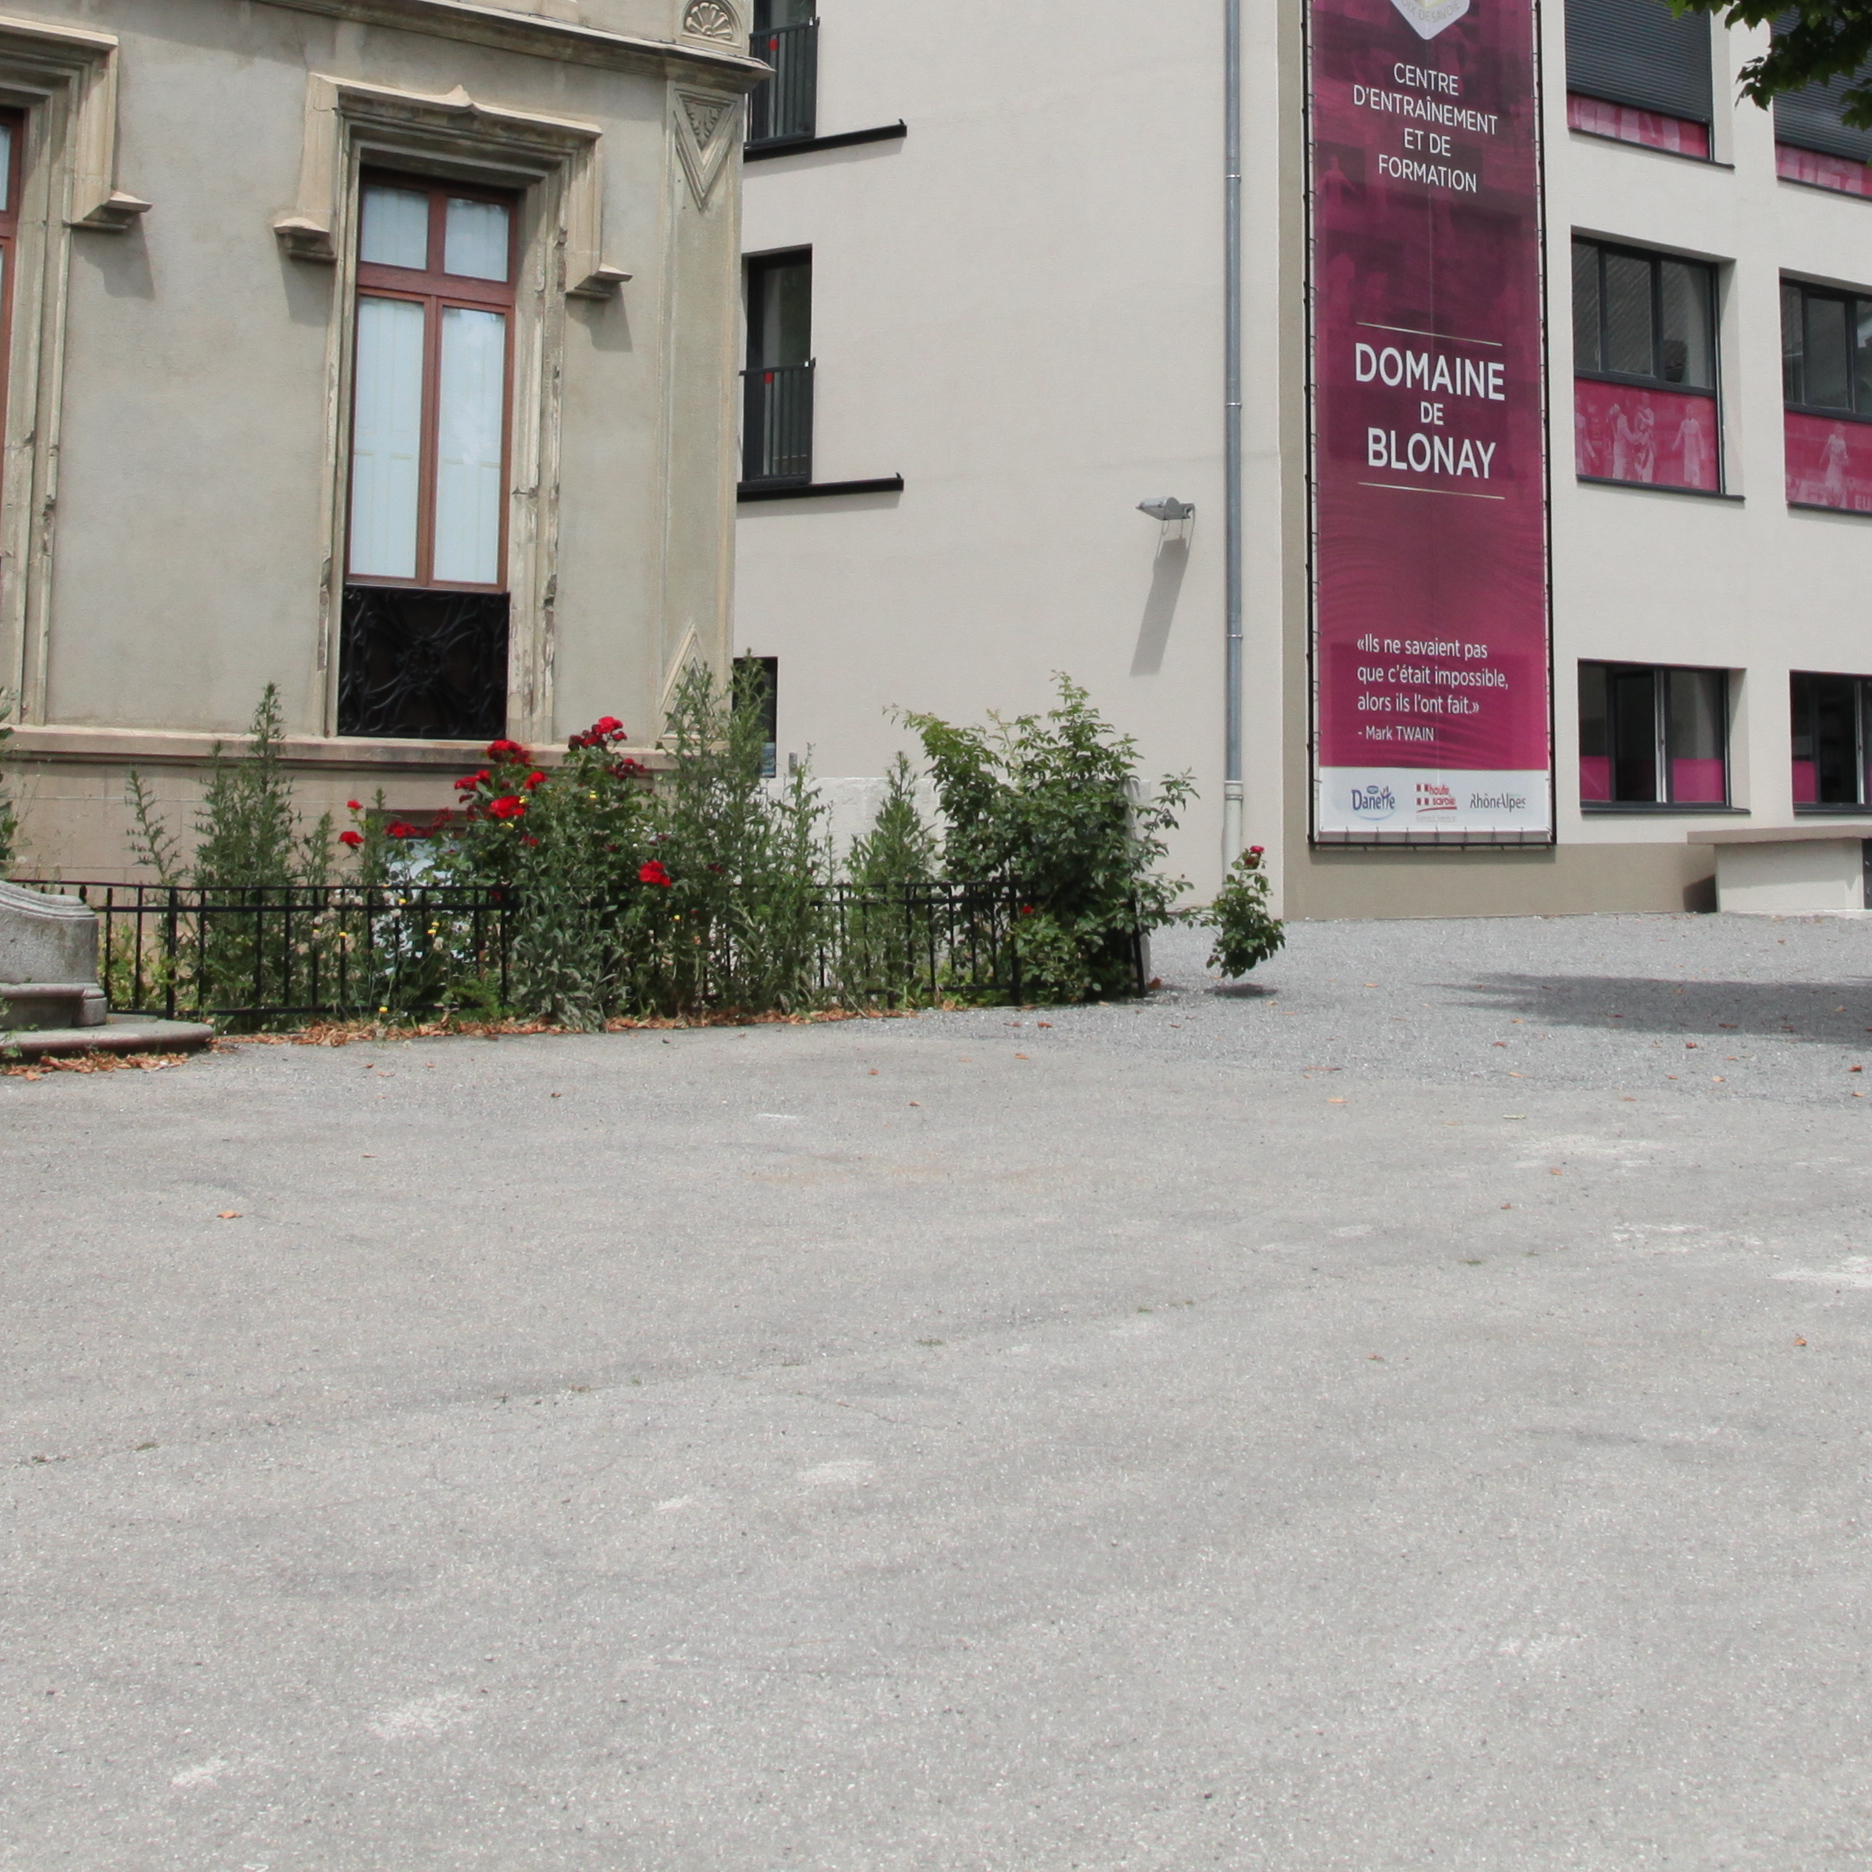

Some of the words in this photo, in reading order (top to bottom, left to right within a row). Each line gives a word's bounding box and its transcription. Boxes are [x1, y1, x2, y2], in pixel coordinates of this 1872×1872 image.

[1393, 62, 1459, 96] CENTRE
[1353, 84, 1498, 135] D'ENTRAÎNEMENT
[1404, 127, 1424, 151] ET
[1429, 133, 1451, 157] DE
[1378, 153, 1477, 194] FORMATION
[1355, 342, 1506, 401] DOMAINE
[1420, 401, 1444, 425] DE
[1367, 426, 1496, 479] BLONAY
[1384, 638, 1401, 654] ne
[1404, 637, 1461, 657] savaient
[1464, 643, 1488, 661] pas
[1357, 666, 1384, 685] que
[1388, 664, 1430, 684] c'était
[1434, 665, 1509, 690] impossible,
[1357, 691, 1392, 711] alors
[1395, 693, 1410, 712] ils
[1414, 693, 1443, 713] l'ont
[1365, 725, 1393, 741] Mark
[1395, 725, 1435, 742] TWAIN
[1351, 786, 1395, 810] Danette
